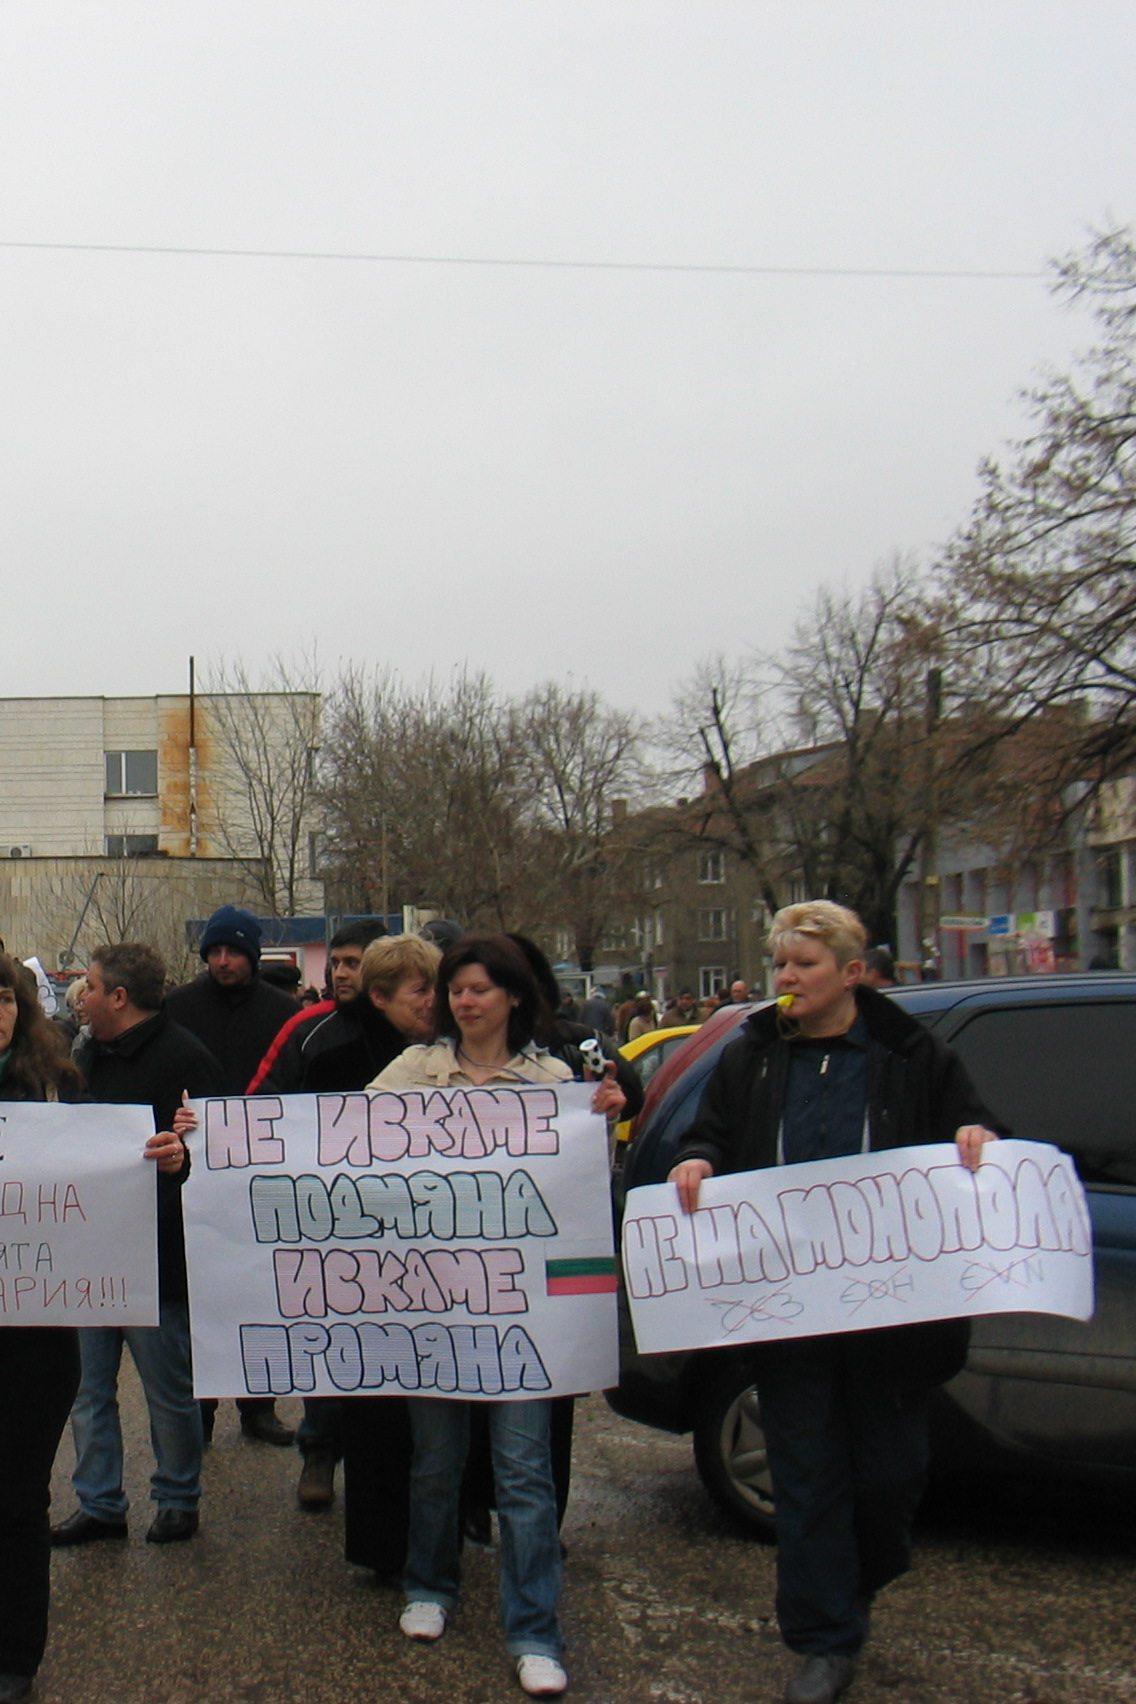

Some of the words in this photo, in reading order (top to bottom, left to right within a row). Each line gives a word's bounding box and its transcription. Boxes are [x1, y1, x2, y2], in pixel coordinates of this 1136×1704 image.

[205, 1096, 285, 1170] НЕ
[316, 1088, 560, 1167] ИСКАМЕ
[249, 1168, 559, 1243] ПОДМЯНА
[625, 1214, 689, 1300] НЕ
[690, 1201, 791, 1290] НА
[777, 1157, 1090, 1276] МОНОПОЛА
[272, 1248, 529, 1318] ИСКАМЕ
[239, 1322, 552, 1394] ПРОМЯНА
